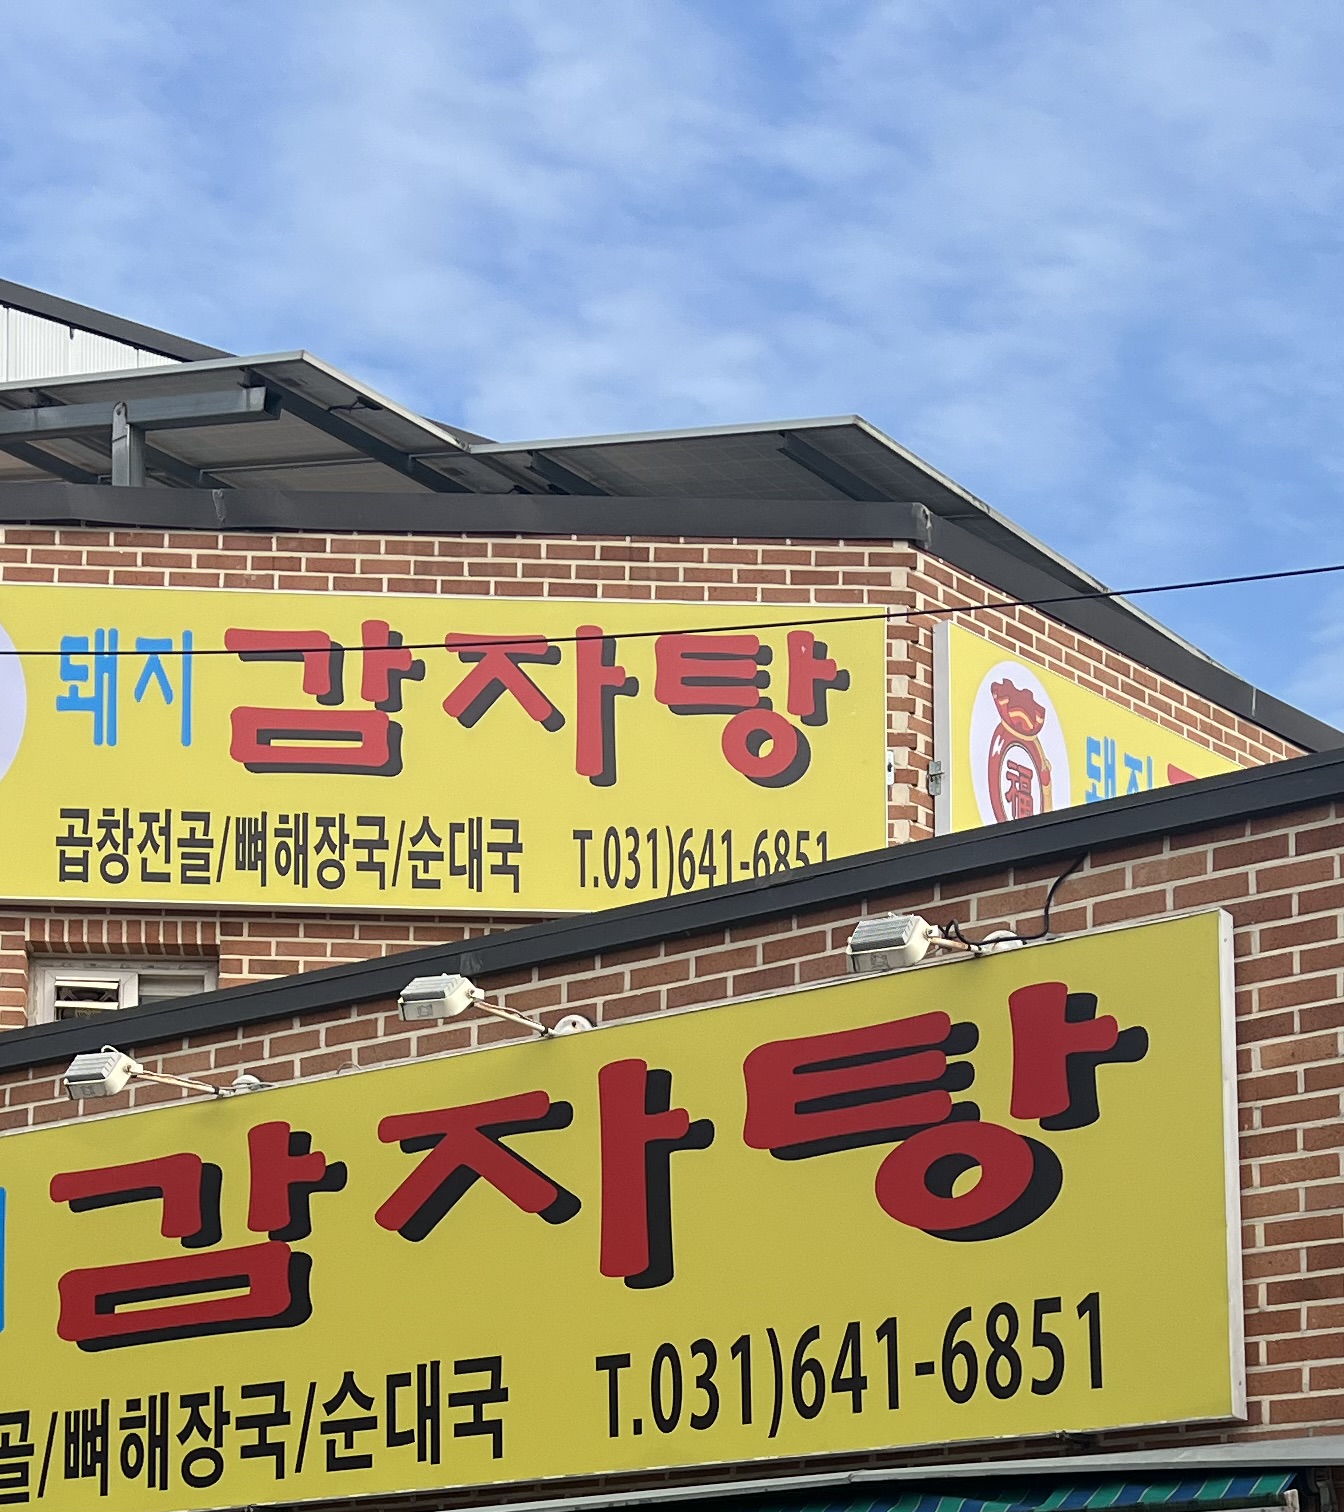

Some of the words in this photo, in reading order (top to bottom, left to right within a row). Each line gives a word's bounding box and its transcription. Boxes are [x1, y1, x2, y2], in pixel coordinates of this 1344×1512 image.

[56, 628, 192, 747] 돼지
[224, 620, 851, 788] 감자탕
[50, 981, 1149, 1353] 감자탕
[595, 1292, 1105, 1440] T.031)641-6851
